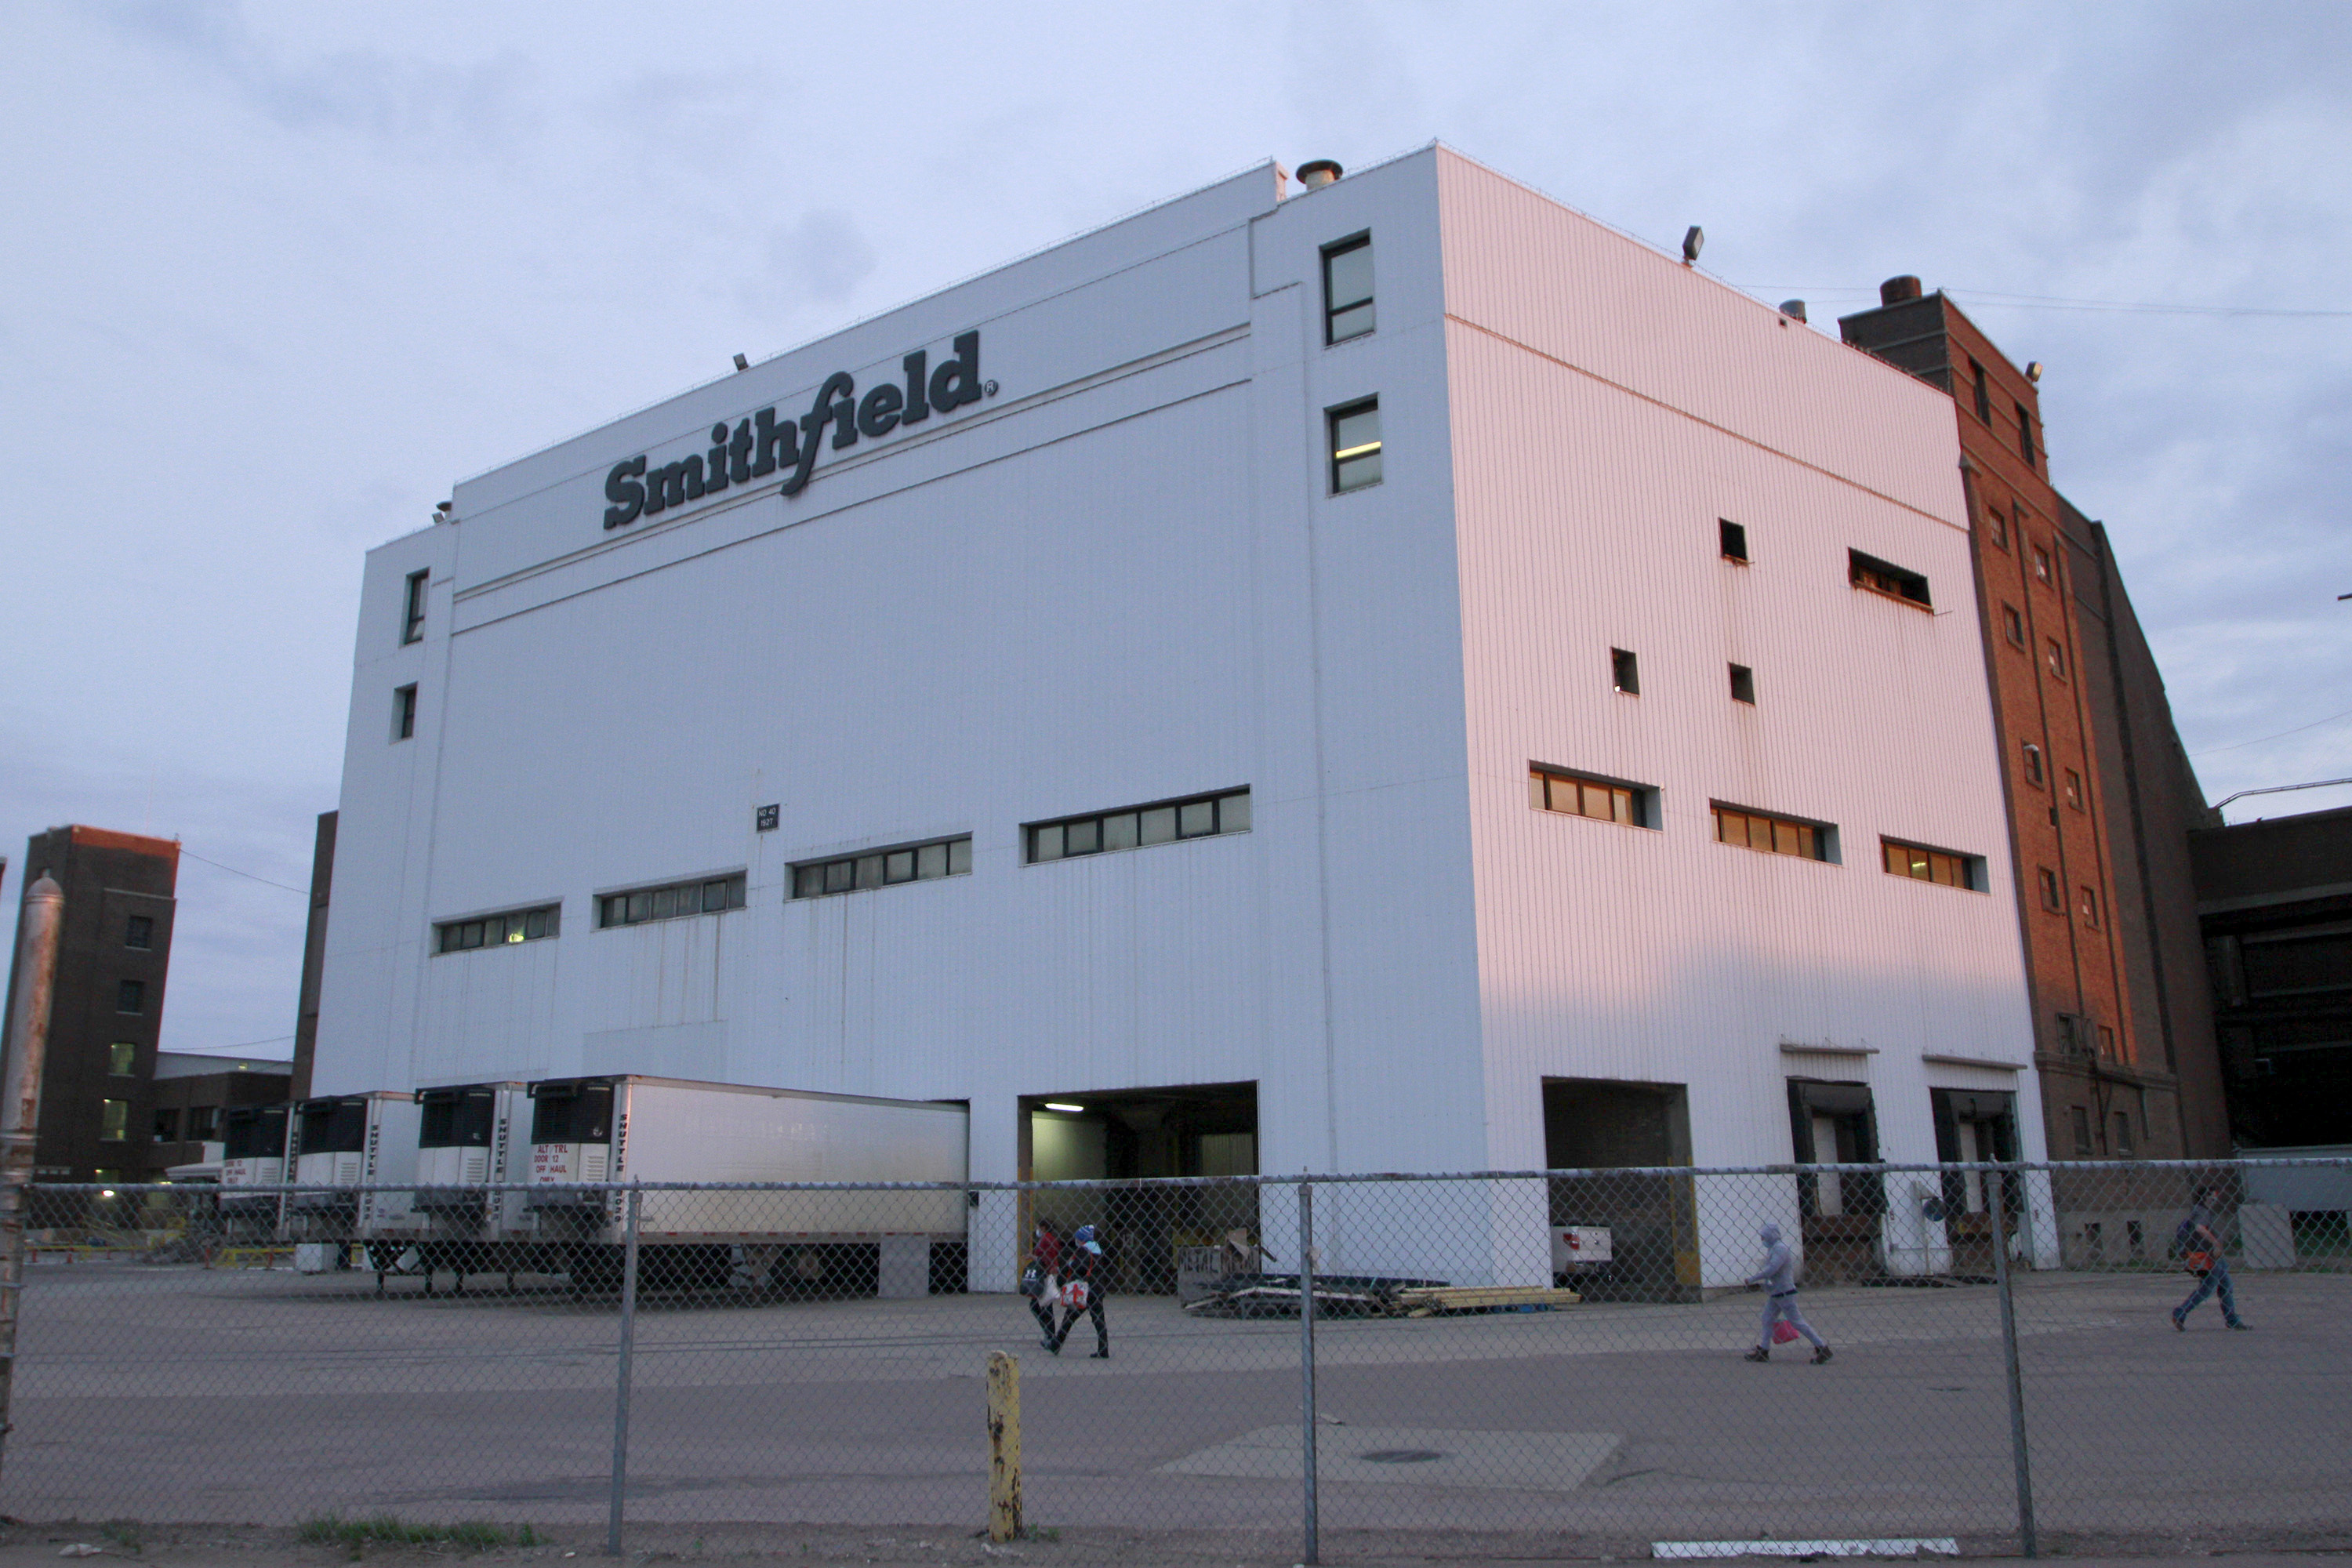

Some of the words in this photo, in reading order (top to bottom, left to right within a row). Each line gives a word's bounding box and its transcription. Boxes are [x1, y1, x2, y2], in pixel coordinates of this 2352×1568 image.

[603, 329, 982, 530] Smithfield
[368, 1125, 378, 1175] SHUTTLE
[495, 1119, 506, 1174] SHUTTLE
[537, 1145, 550, 1153] ALT
[554, 1145, 568, 1153] TRL
[616, 1114, 627, 1171] SHUTTLE
[535, 1165, 546, 1174] OFF
